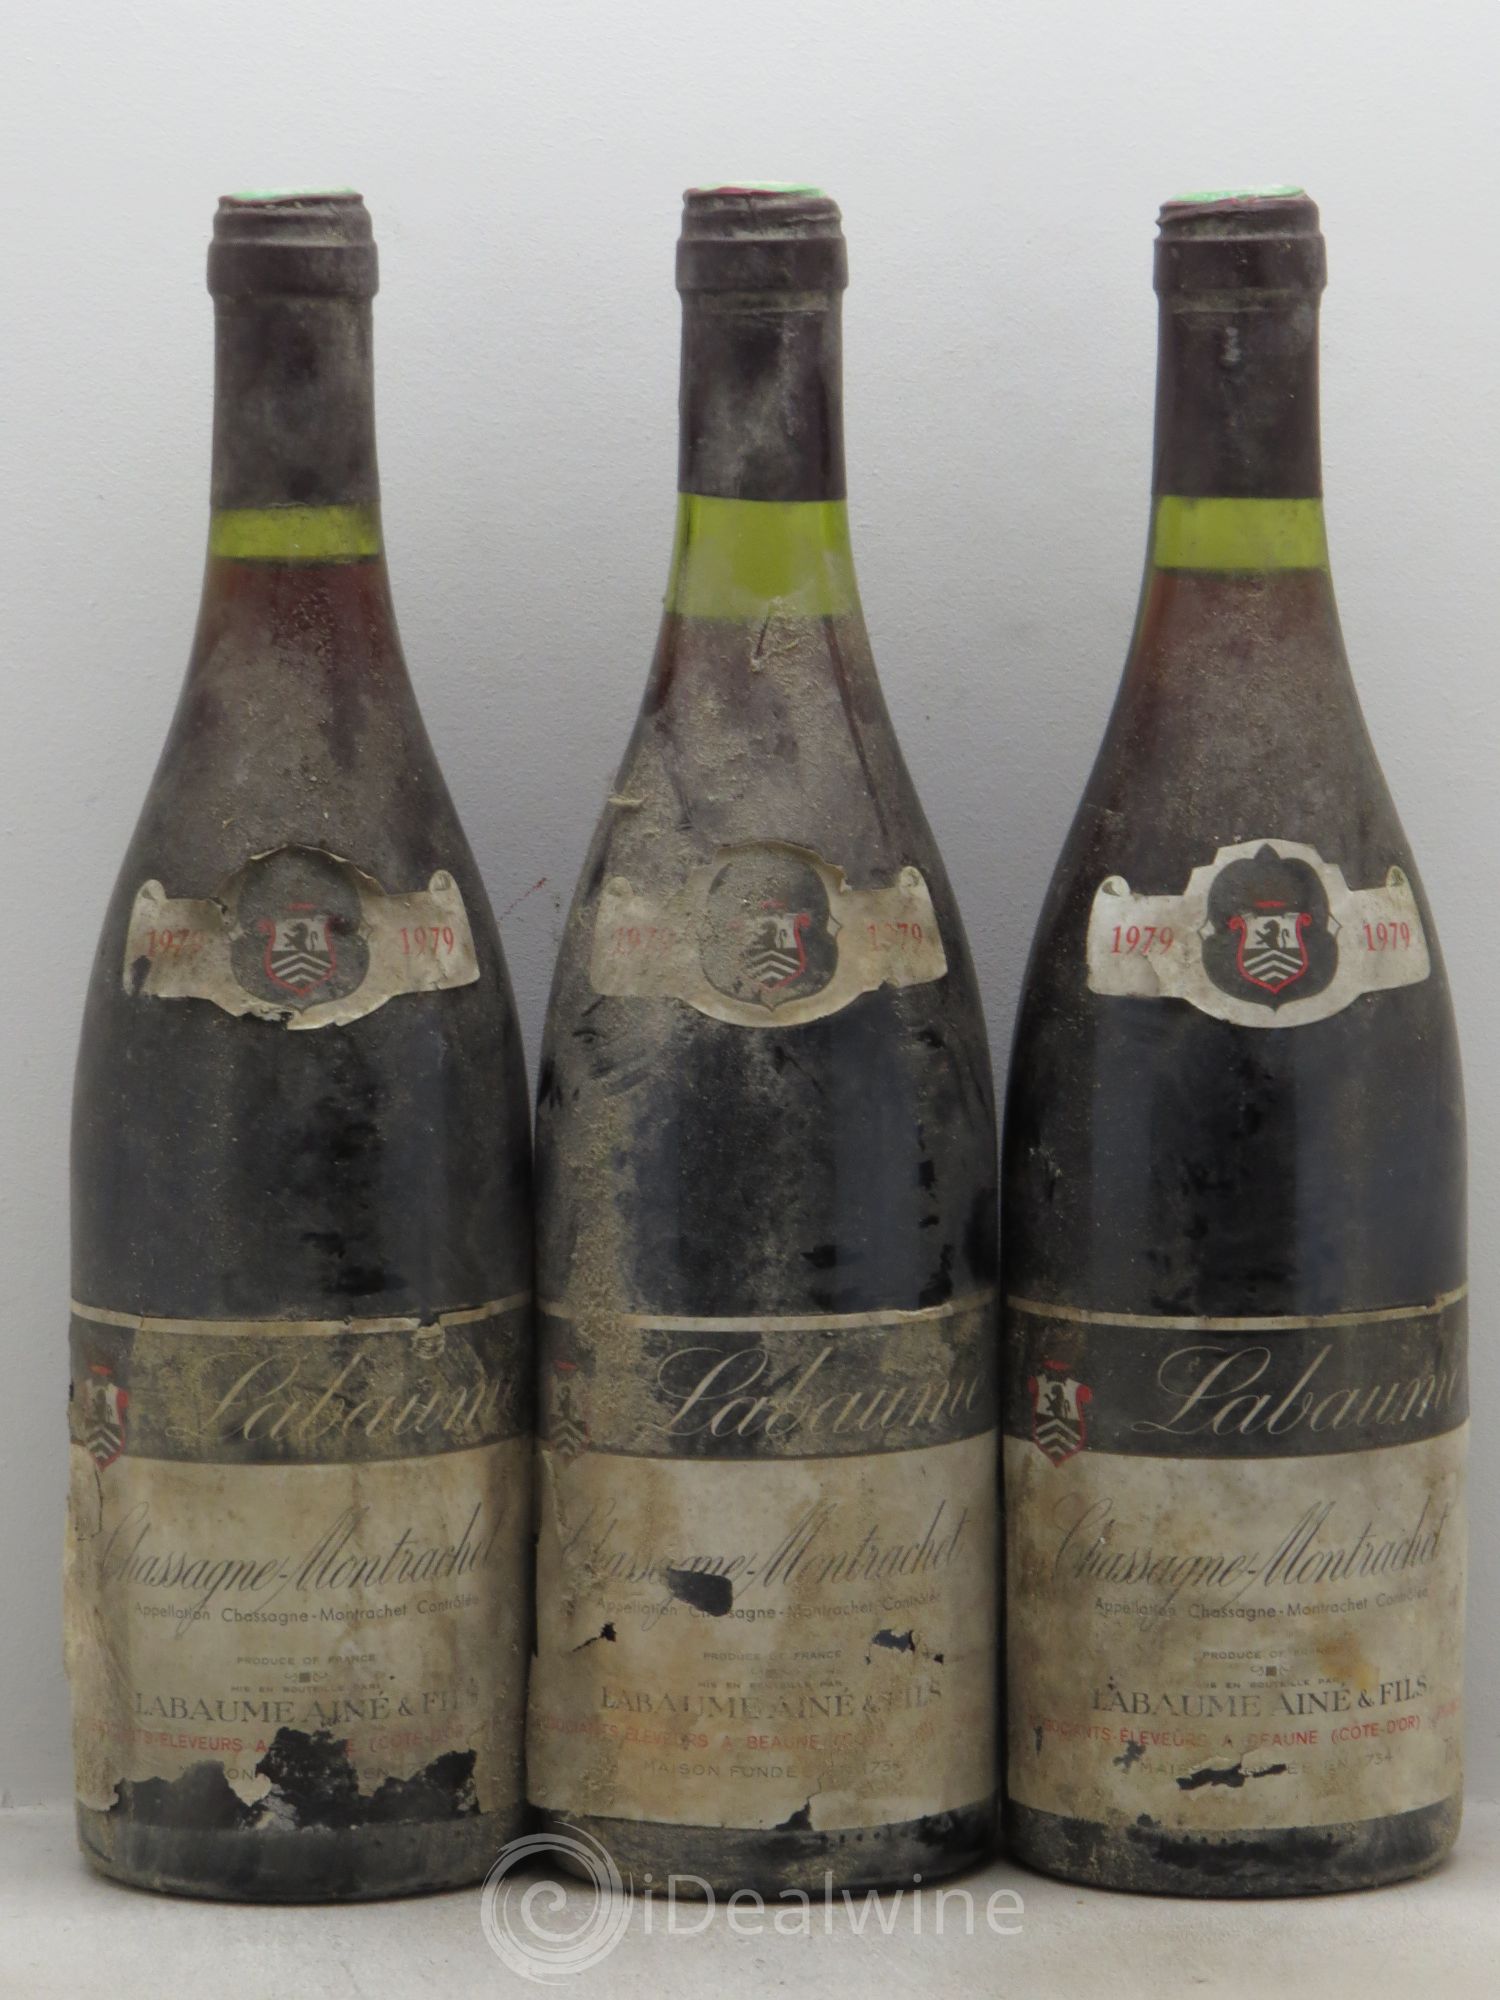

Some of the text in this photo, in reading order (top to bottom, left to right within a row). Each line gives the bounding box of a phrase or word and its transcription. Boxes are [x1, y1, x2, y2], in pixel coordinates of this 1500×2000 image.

[147, 927, 205, 957] 197
[401, 926, 454, 955] 1979
[1110, 926, 1174, 954] 1979
[1363, 922, 1410, 951] 1979
[1095, 1597, 1176, 1617] Appelation
[1202, 1651, 1262, 1660] PRODUCE
[133, 1691, 296, 1724] LABAUME
[397, 1697, 416, 1717] &
[1091, 1687, 1261, 1718] LABAUME
[1357, 1688, 1376, 1709] &
[1380, 1674, 1428, 1705] FILS
